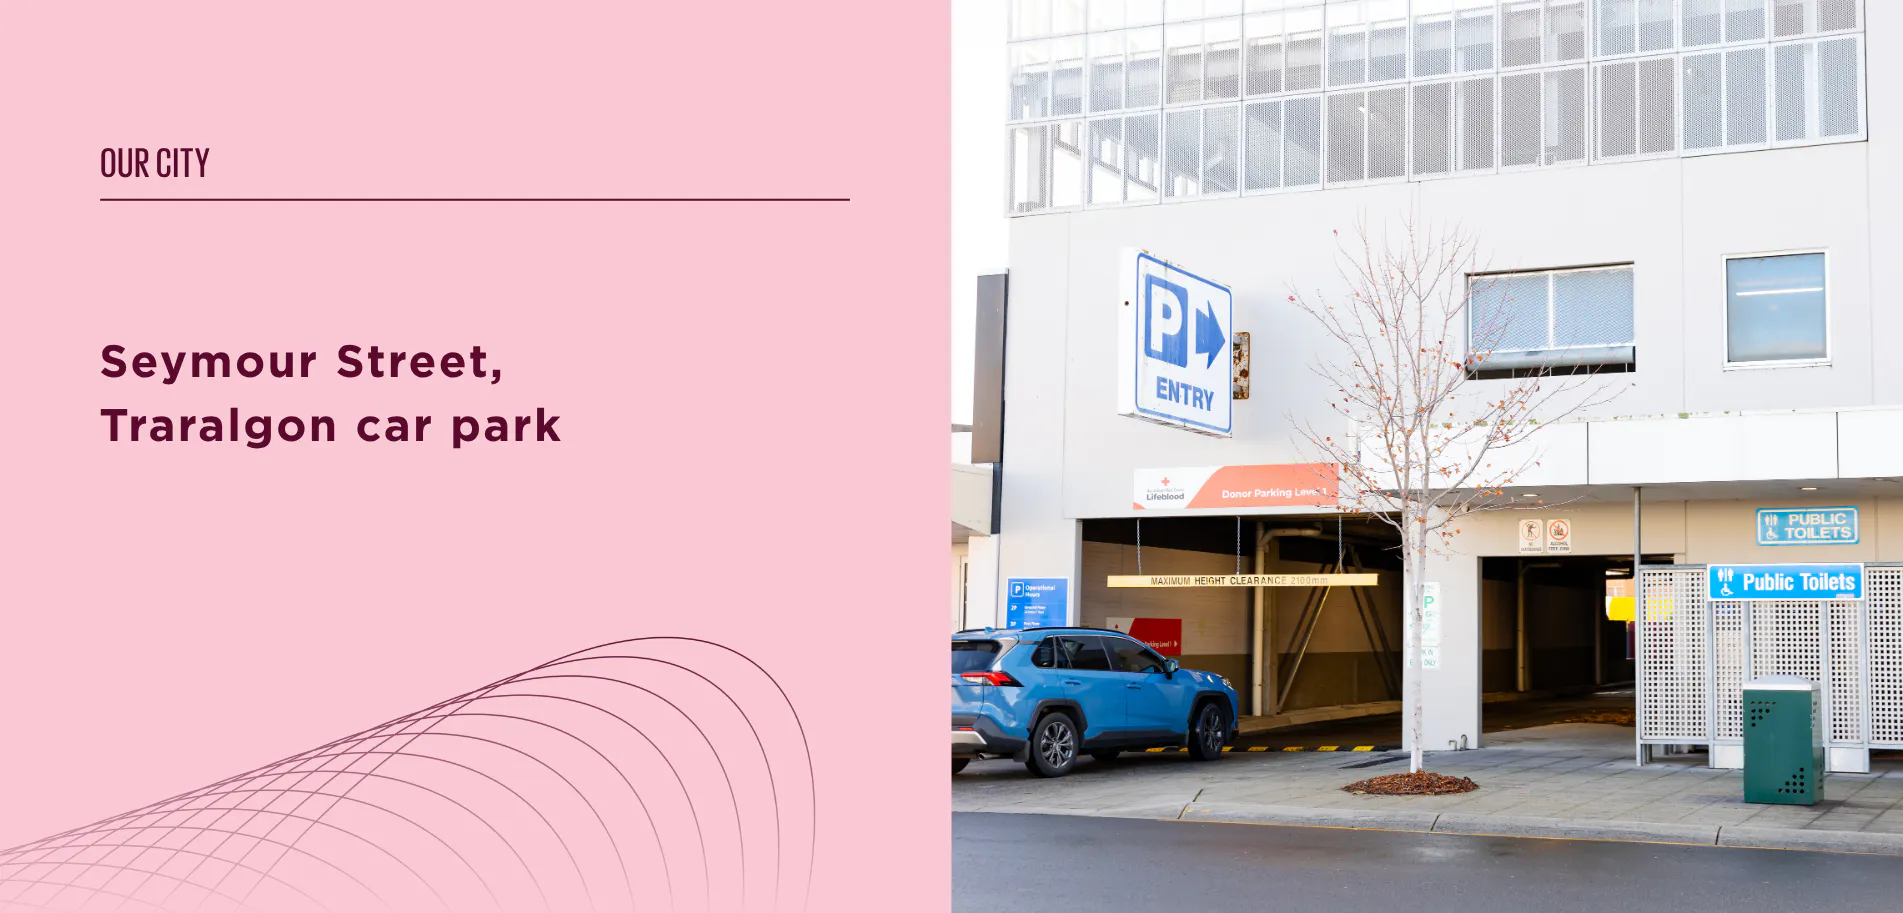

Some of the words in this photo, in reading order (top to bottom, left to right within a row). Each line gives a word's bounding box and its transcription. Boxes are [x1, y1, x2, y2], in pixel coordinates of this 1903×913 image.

[1151, 284, 1183, 353] P
[1156, 375, 1215, 412] ENTRY
[1146, 492, 1185, 501] Lifeblood
[1221, 490, 1252, 499] Donor
[1254, 487, 1292, 499] Parking
[1294, 487, 1320, 497] Level
[1322, 487, 1328, 495] 1
[1788, 512, 1847, 526] PUBLIC
[1784, 526, 1852, 539] TOILETS
[1150, 576, 1191, 586] MAXIMUM
[1194, 576, 1226, 585] HEIGHT
[1230, 575, 1287, 585] CLEARANCE
[1290, 576, 1328, 585] 2100mm
[1743, 573, 1795, 591] Public
[1800, 572, 1856, 591] Toilets
[1015, 585, 1021, 594] P
[1025, 584, 1056, 592] Operational
[1423, 595, 1435, 609] P
